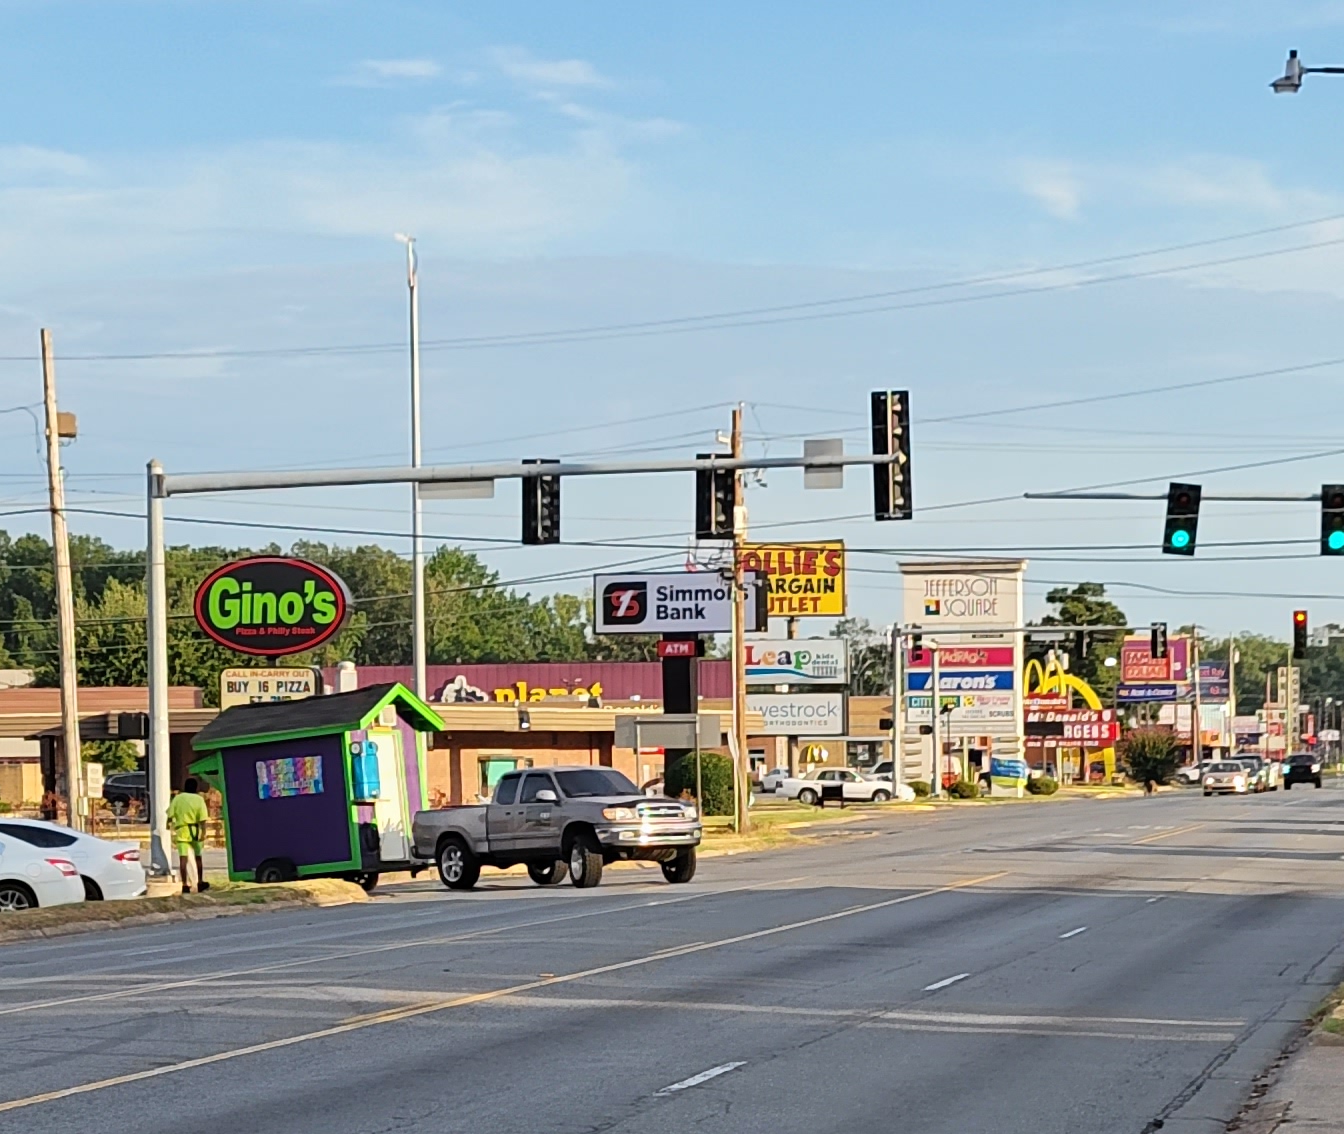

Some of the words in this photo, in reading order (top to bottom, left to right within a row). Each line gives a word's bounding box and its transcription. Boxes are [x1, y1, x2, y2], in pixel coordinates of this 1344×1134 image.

[767, 577, 835, 594] ARGAIN
[924, 578, 998, 597] JEFFERSON
[209, 577, 337, 629] Gino's
[768, 596, 821, 613] UTLET
[944, 599, 998, 617] SQUARE
[656, 604, 706, 620] Bank
[236, 627, 257, 635] Pizza
[267, 627, 290, 636] Philly
[291, 627, 316, 635] Steak
[666, 643, 689, 655] ATM
[744, 645, 812, 670] Leap
[225, 670, 248, 678] CALL
[292, 670, 311, 678] OUT
[227, 681, 249, 693] BUY
[277, 681, 311, 693] PIZZA
[752, 701, 838, 718] westrock
